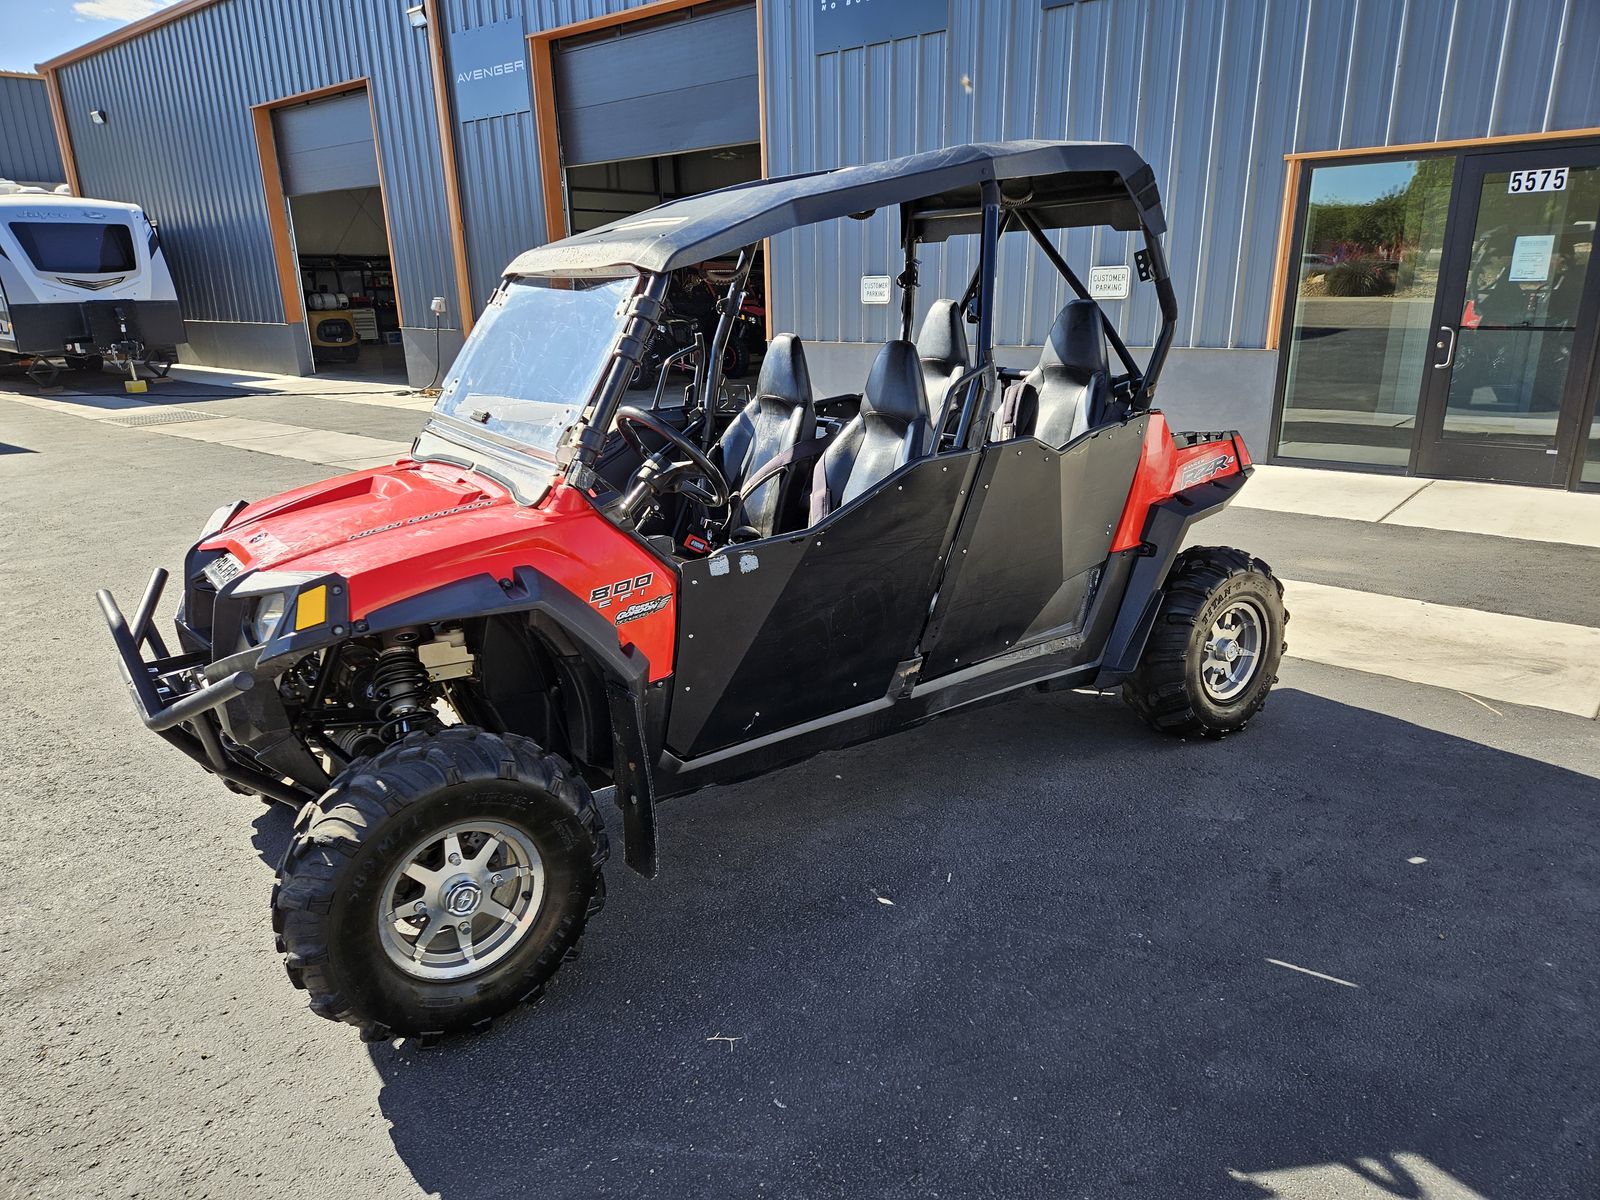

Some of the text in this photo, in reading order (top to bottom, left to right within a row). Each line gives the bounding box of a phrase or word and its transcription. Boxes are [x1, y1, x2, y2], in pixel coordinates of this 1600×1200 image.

[457, 60, 525, 84] AVENGER
[1511, 169, 1565, 192] 5575
[864, 281, 888, 289] CUSTOMER
[1093, 273, 1126, 282] CUSTOMER
[1095, 283, 1122, 291] PARKING
[589, 571, 654, 604] 800
[599, 588, 646, 609] EFI
